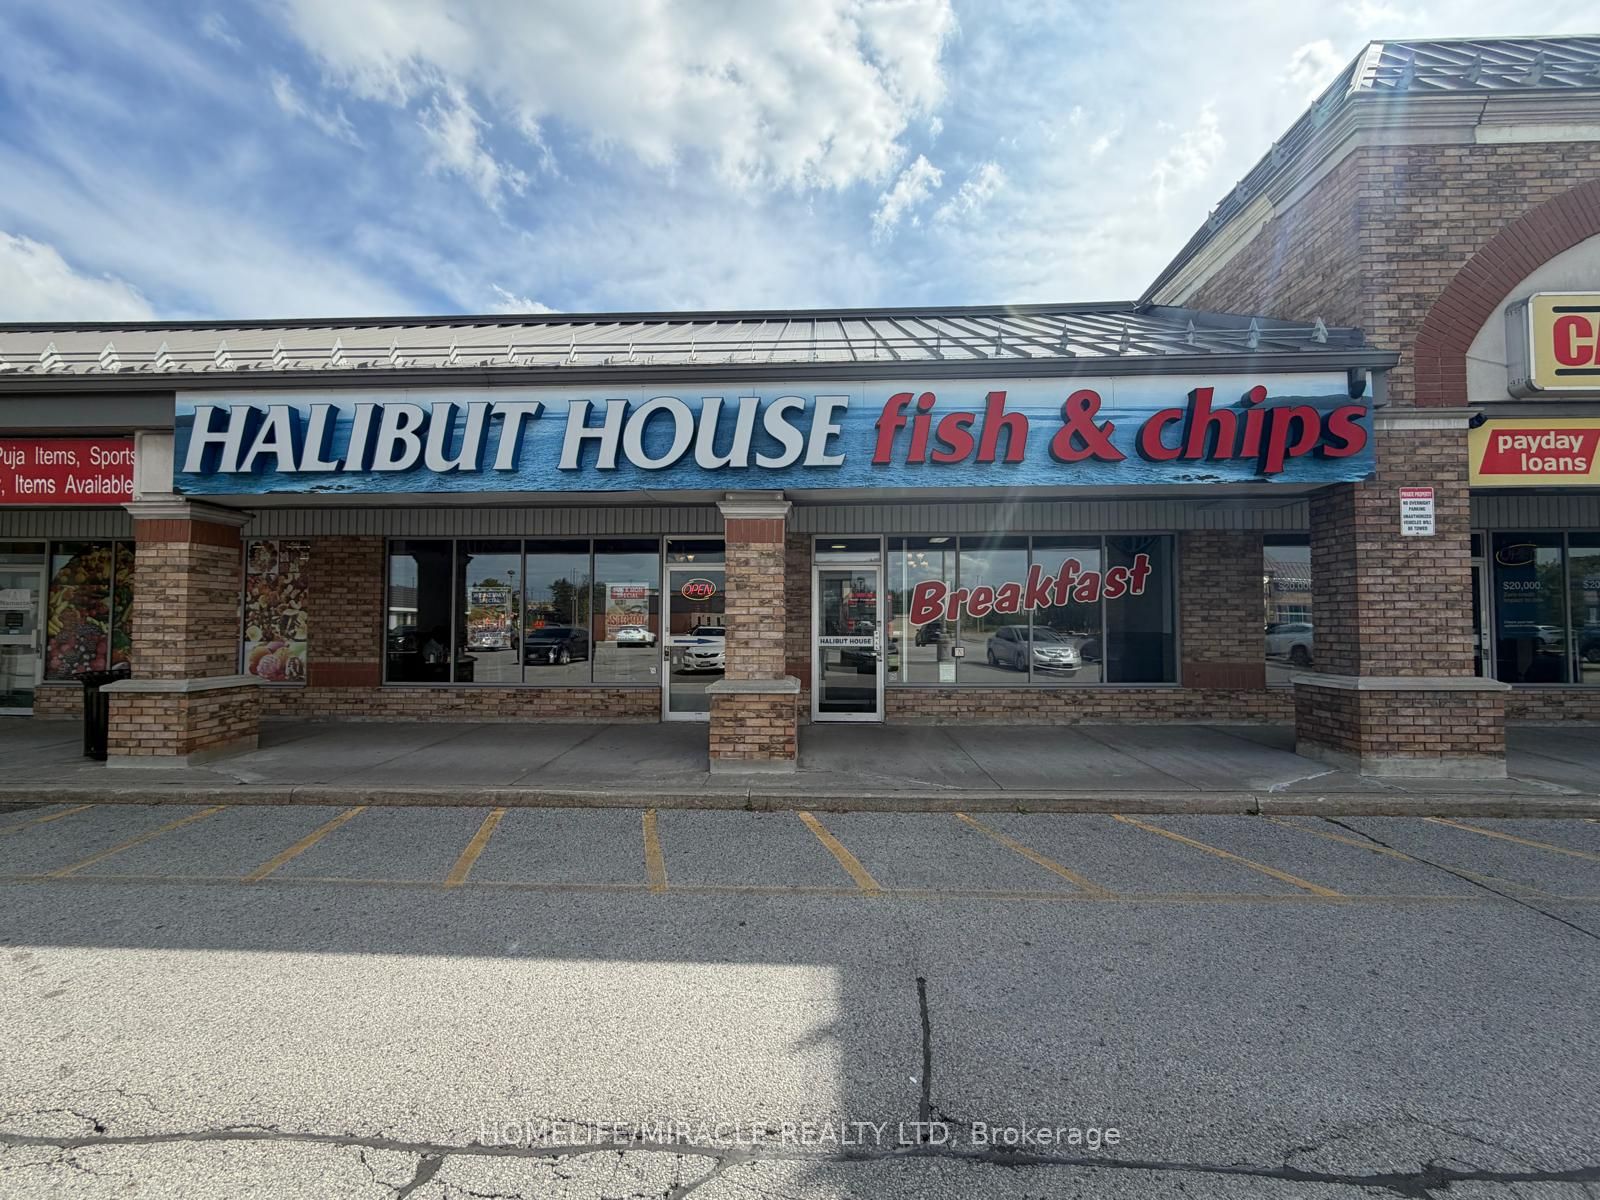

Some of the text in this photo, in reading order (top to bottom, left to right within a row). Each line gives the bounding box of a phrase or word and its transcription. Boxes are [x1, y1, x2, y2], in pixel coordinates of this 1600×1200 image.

[1553, 315, 1600, 367] C
[182, 385, 1368, 476] HALIBUT HOUSE fish & chips
[1498, 431, 1584, 453] payday
[0, 447, 26, 469] uja
[35, 446, 80, 467] Items,
[1521, 453, 1587, 471] loans
[15, 474, 56, 494] Items
[65, 474, 134, 494] Available
[683, 583, 713, 595] OPEN
[909, 553, 1151, 625] Breakfast
